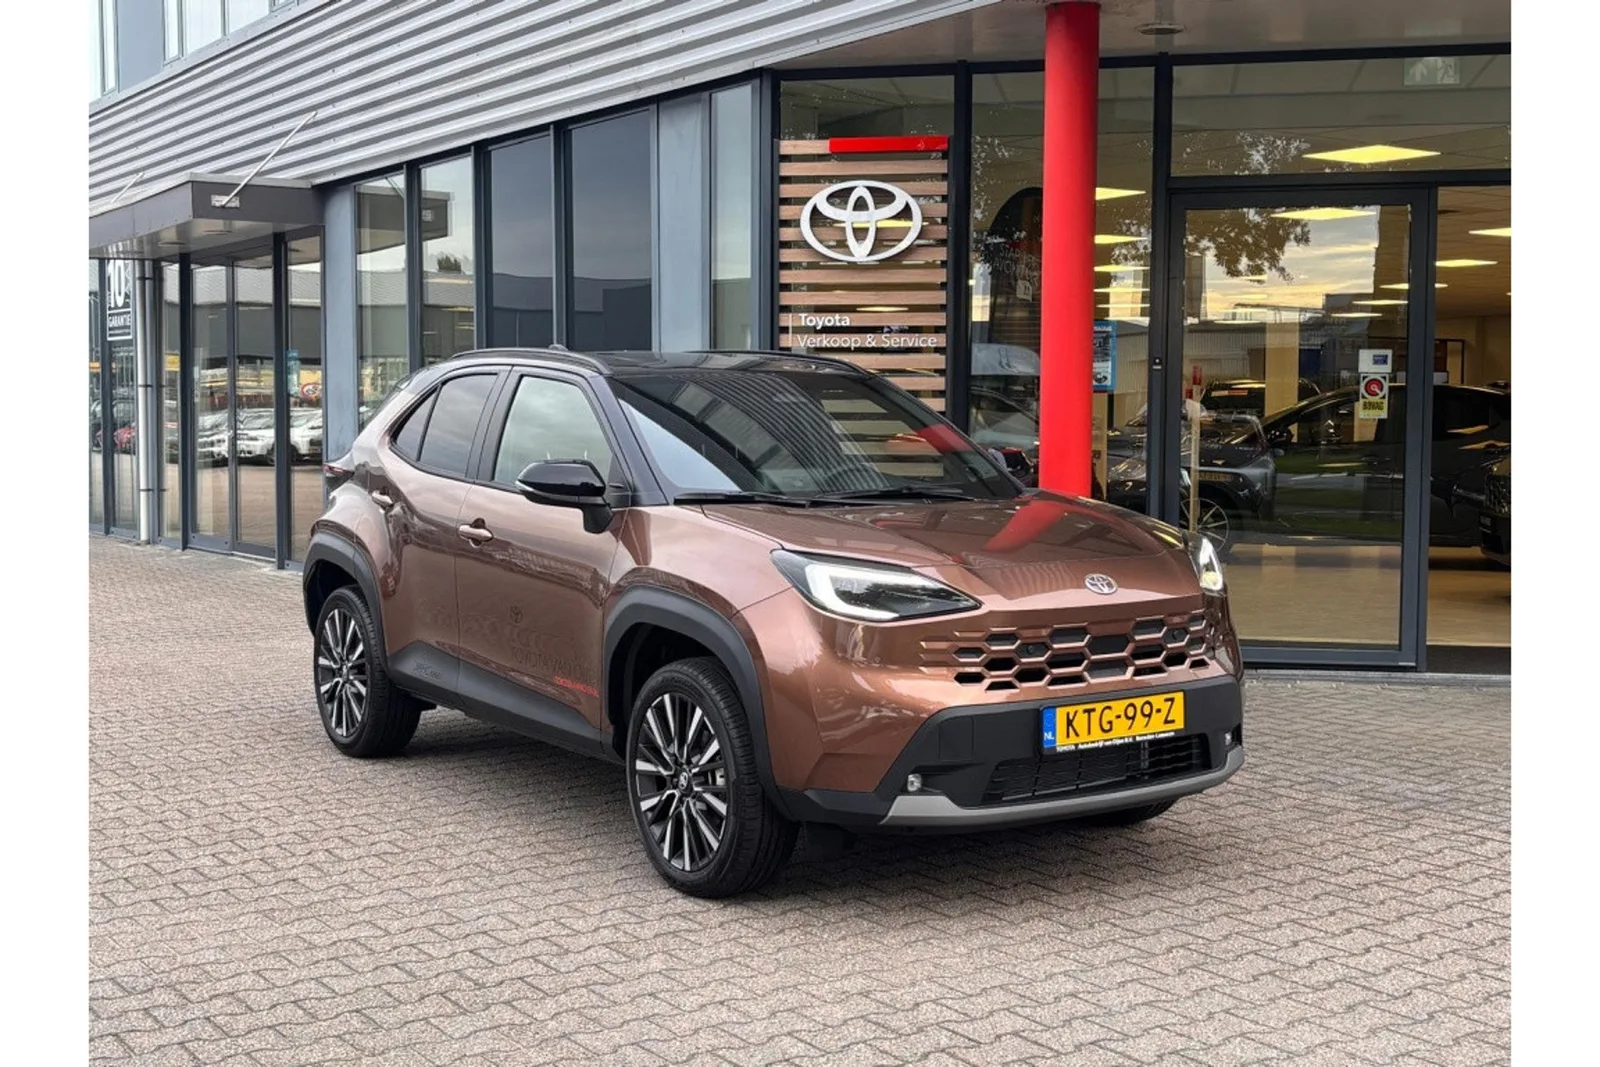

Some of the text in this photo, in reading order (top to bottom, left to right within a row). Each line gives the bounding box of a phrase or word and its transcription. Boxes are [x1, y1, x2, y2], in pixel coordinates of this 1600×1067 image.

[799, 313, 850, 329] Toyota
[798, 334, 937, 350] Verkoop & Service
[1066, 697, 1175, 738] KTG-99-Z
[1044, 731, 1055, 740] NL
